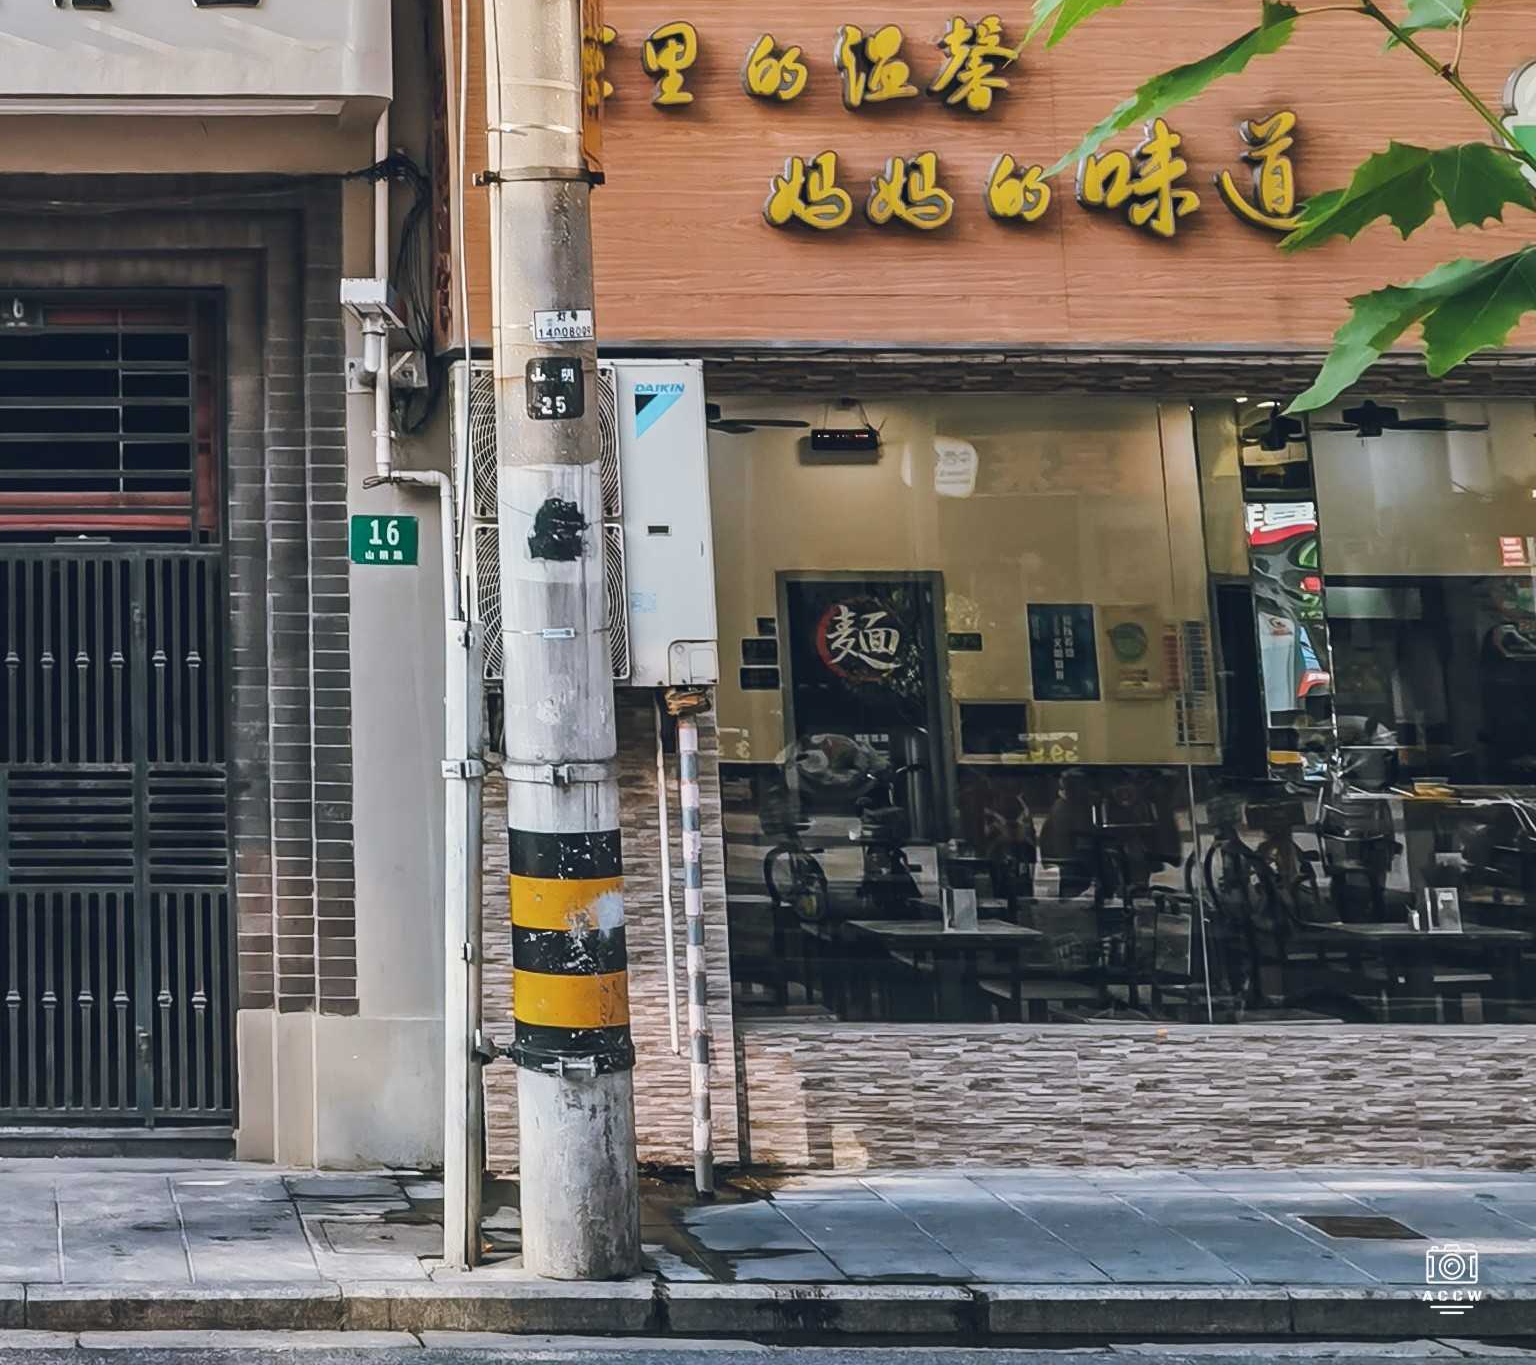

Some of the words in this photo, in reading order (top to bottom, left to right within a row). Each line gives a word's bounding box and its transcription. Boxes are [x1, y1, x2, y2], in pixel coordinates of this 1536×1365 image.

[602, 16, 1018, 113] 里的温馨
[763, 111, 1310, 238] 妈妈的味道
[634, 383, 686, 393] DAIKIN
[541, 395, 567, 415] 25
[368, 518, 400, 546] 16
